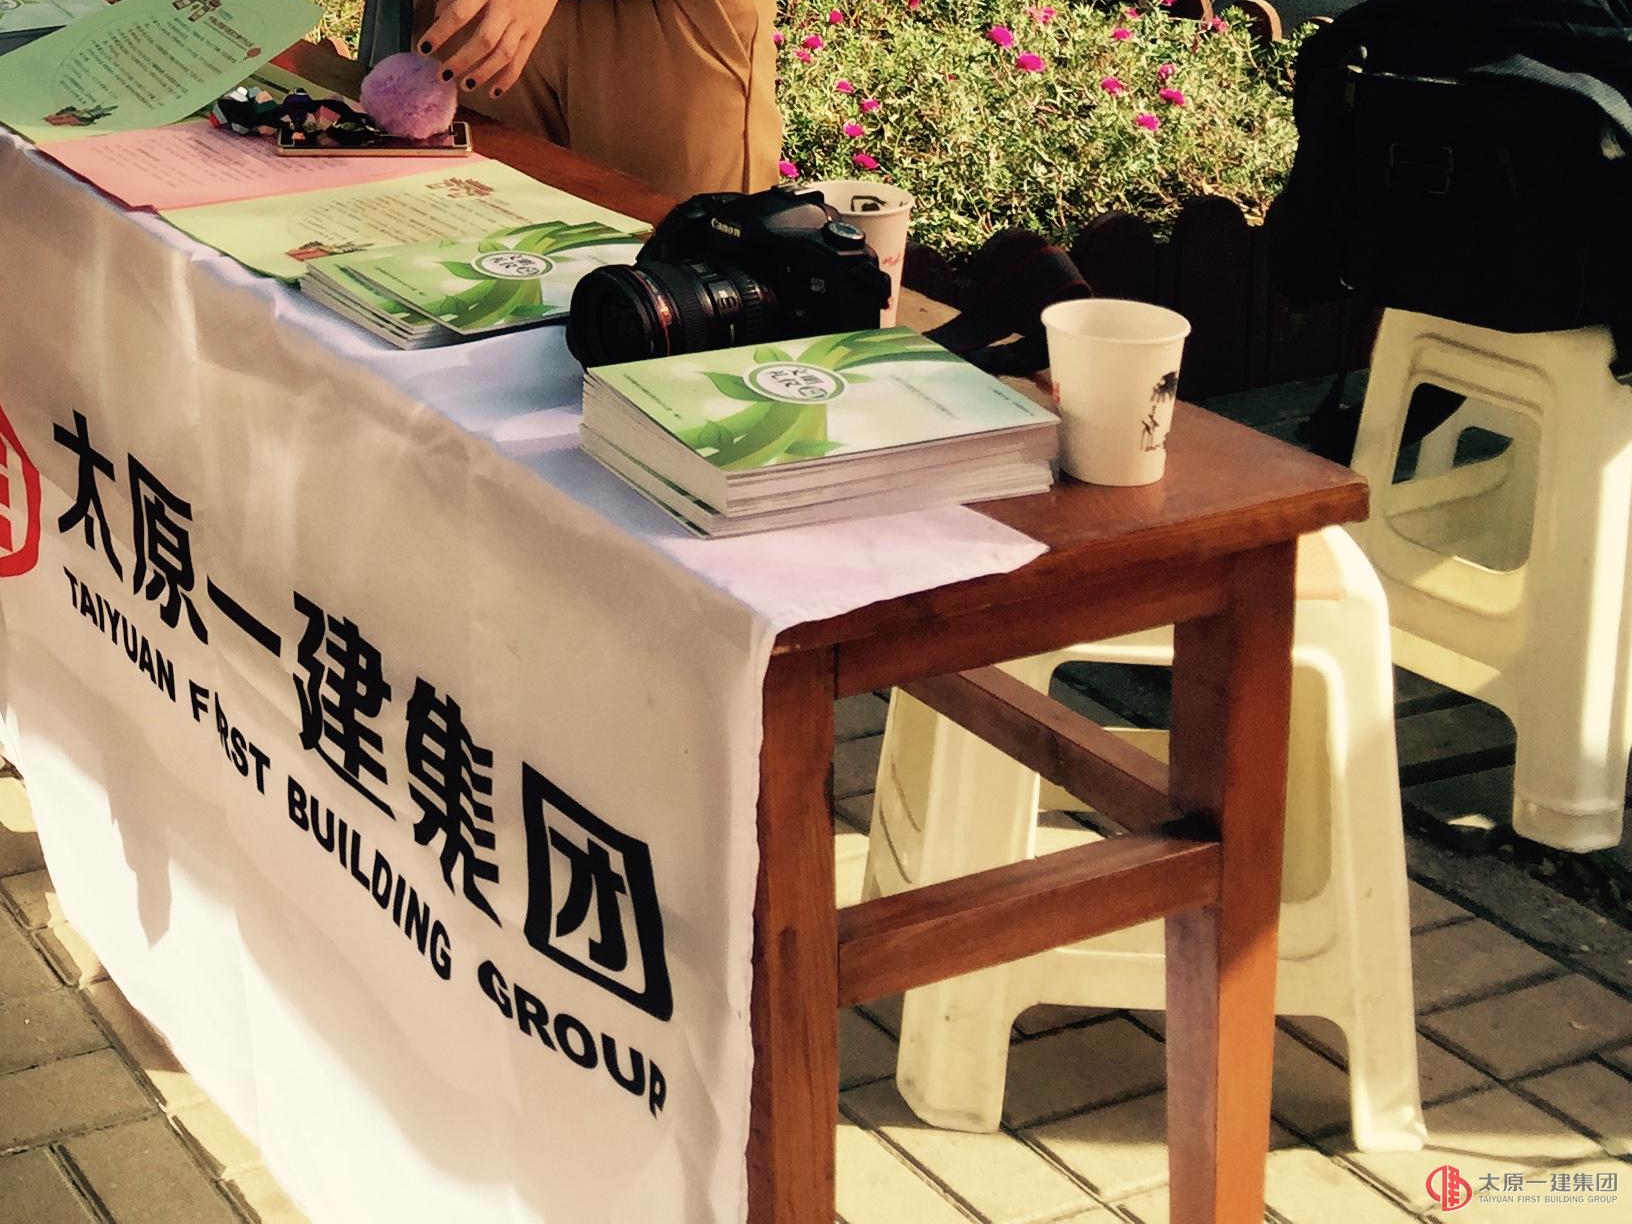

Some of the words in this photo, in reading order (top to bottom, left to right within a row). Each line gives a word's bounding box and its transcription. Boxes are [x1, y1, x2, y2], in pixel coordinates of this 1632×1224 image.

[710, 217, 742, 239] Canon
[52, 411, 673, 1022] 太原一建集团
[63, 565, 176, 703] TAIYUAN
[189, 679, 271, 795] FRST
[287, 775, 452, 981] BUILDING
[477, 960, 667, 1120] GROUP
